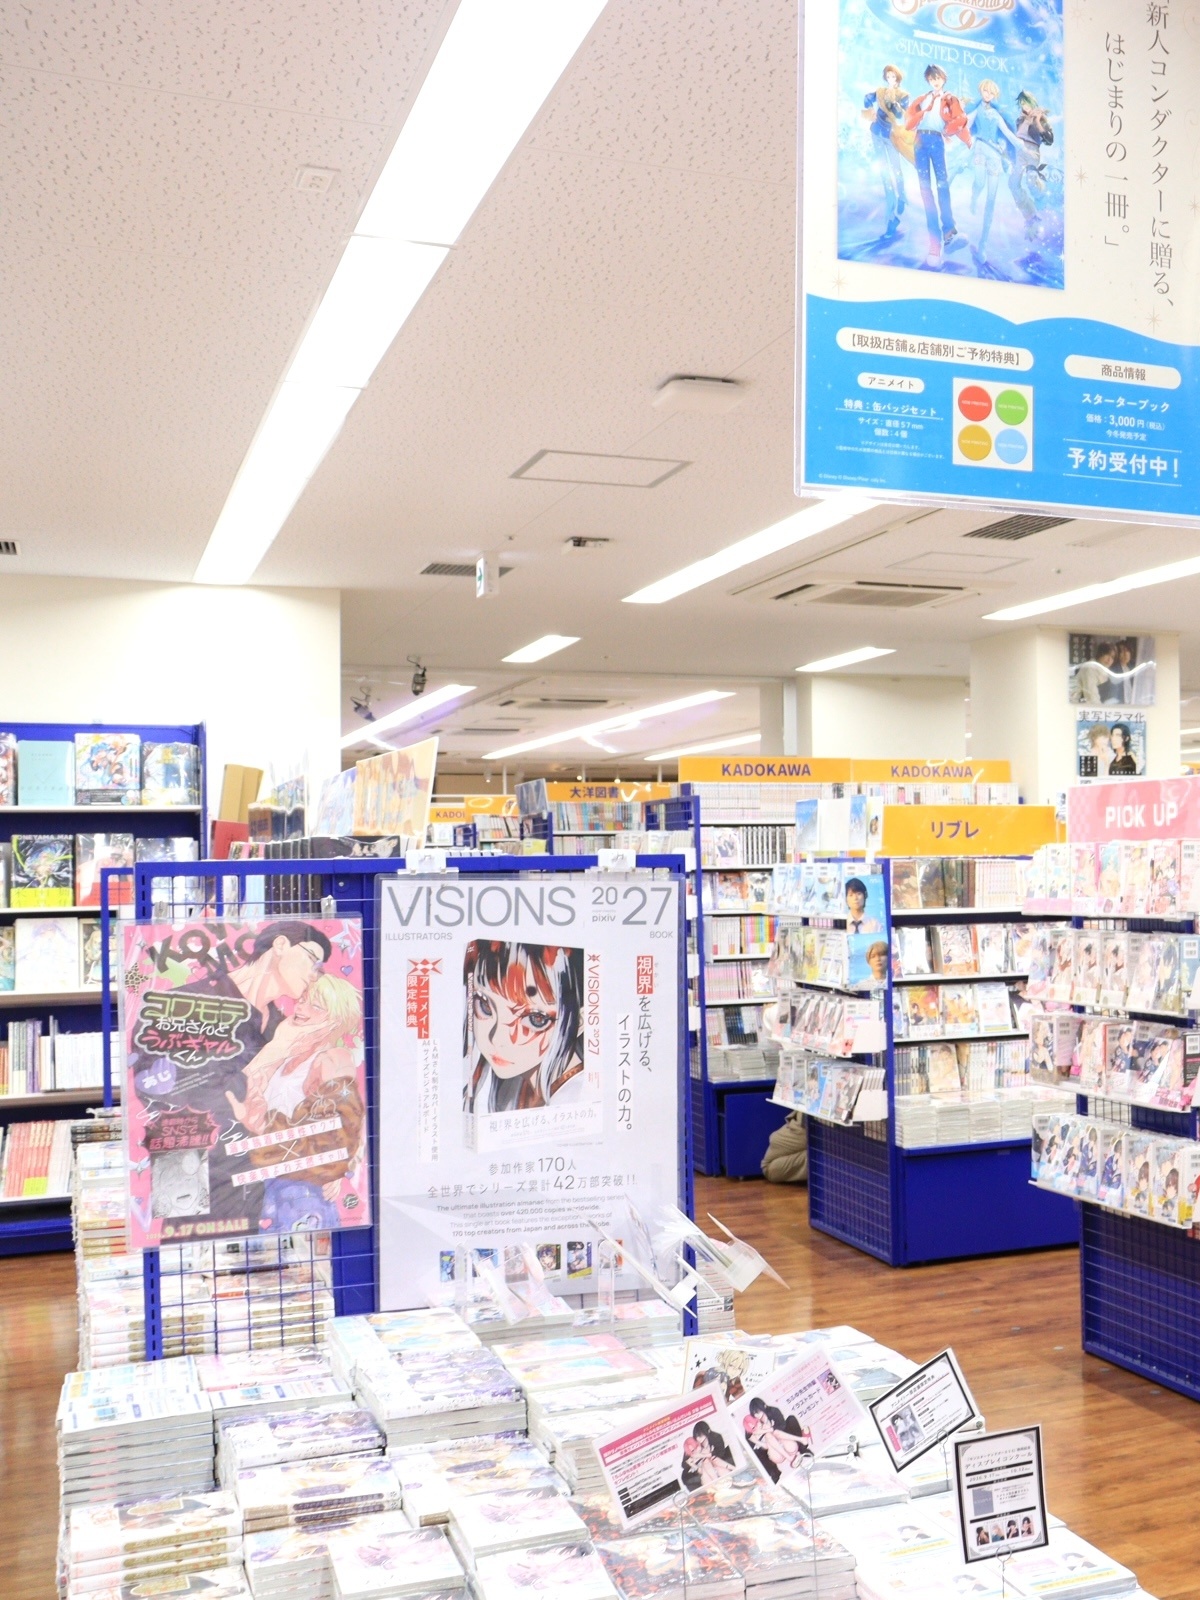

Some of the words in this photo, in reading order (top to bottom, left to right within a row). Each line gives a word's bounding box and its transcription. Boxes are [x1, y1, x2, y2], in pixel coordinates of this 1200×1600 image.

[896, 40, 959, 63] STARTER
[963, 50, 1009, 73] BOOK
[1104, 33, 1129, 248] はじまりの一冊。」
[1146, 2, 1175, 307] 新人コンダクターに贈る、
[1101, 364, 1146, 381] 商品情報
[868, 376, 914, 389] アニメイト
[1082, 393, 1170, 413] スターターブック
[1067, 447, 1180, 479] 予約受付中！
[1079, 710, 1145, 723] 実写ドラマ化
[722, 763, 811, 777] KADOKAWA
[890, 765, 973, 778] KADOKAWA
[570, 786, 619, 798] 大洋図書
[436, 811, 465, 819] KADO
[1105, 804, 1145, 829] PICK
[1153, 802, 1178, 827] UP
[930, 821, 980, 838] リブレ
[387, 886, 576, 927] VISIONS
[591, 886, 618, 905] 20
[622, 887, 673, 926] 27
[592, 913, 616, 923] pixiv
[385, 933, 453, 941] ILLUSTRATORS
[649, 931, 674, 939] BOOK
[407, 975, 418, 1026] 限定特典
[588, 964, 600, 1026] VISIONS
[419, 975, 429, 1037] アニメイト
[637, 956, 653, 1072] 視界を広げる、
[156, 1016, 230, 1037] お兄さんと
[143, 1029, 238, 1053] うぶギャル
[173, 1050, 203, 1063] くん
[618, 1014, 632, 1130] イラストの力。
[489, 1156, 577, 1175] 参加作家170人
[437, 1204, 449, 1212] The
[451, 1202, 479, 1211] ultimate
[480, 1200, 516, 1209] illustration
[517, 1199, 544, 1207] almanac
[561, 1196, 571, 1204] the
[572, 1194, 606, 1204] bestselling
[544, 1207, 565, 1215] copies
[217, 1218, 249, 1232] SALE
[551, 1213, 583, 1222] exception
[477, 1228, 505, 1236] creators
[506, 1226, 522, 1234] from
[523, 1225, 542, 1233] Japan
[557, 1222, 578, 1230] across
